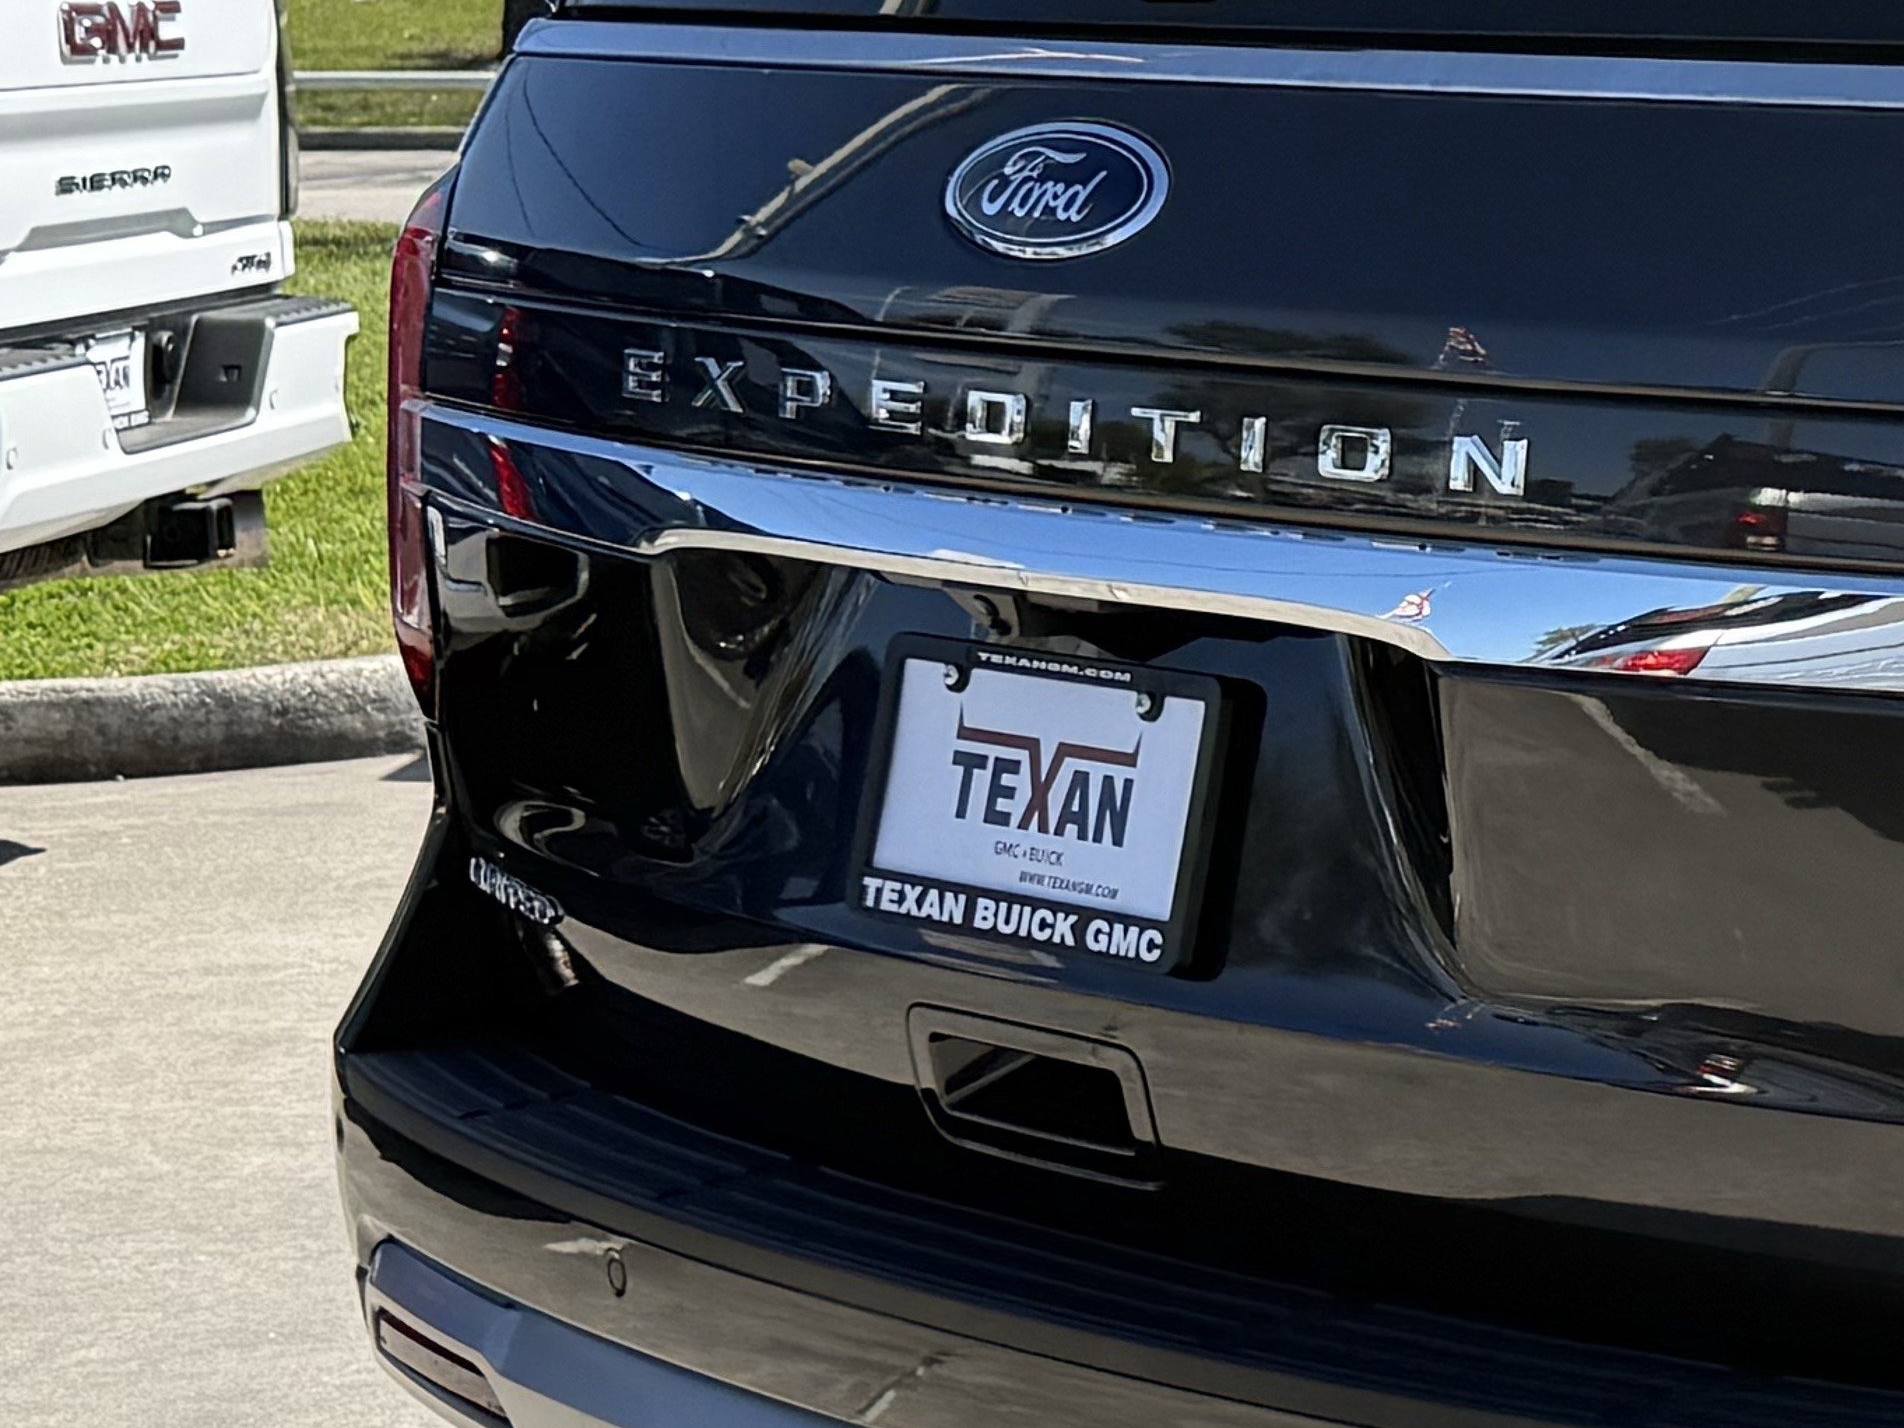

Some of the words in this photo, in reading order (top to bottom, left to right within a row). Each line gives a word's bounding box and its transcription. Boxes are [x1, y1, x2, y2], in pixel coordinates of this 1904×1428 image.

[57, 0, 185, 65] GMC
[55, 165, 171, 196] SIERRA
[981, 145, 1106, 225] Ford
[622, 348, 1529, 497] EXPEDITION
[977, 651, 1132, 683] TEXANGM.COM
[952, 701, 1142, 849] TEXAN
[994, 840, 1021, 859] GMC
[1029, 846, 1065, 867] BUICK
[862, 877, 965, 925] TEXAN
[973, 899, 1078, 947] BUICK
[1085, 919, 1164, 963] GMC
